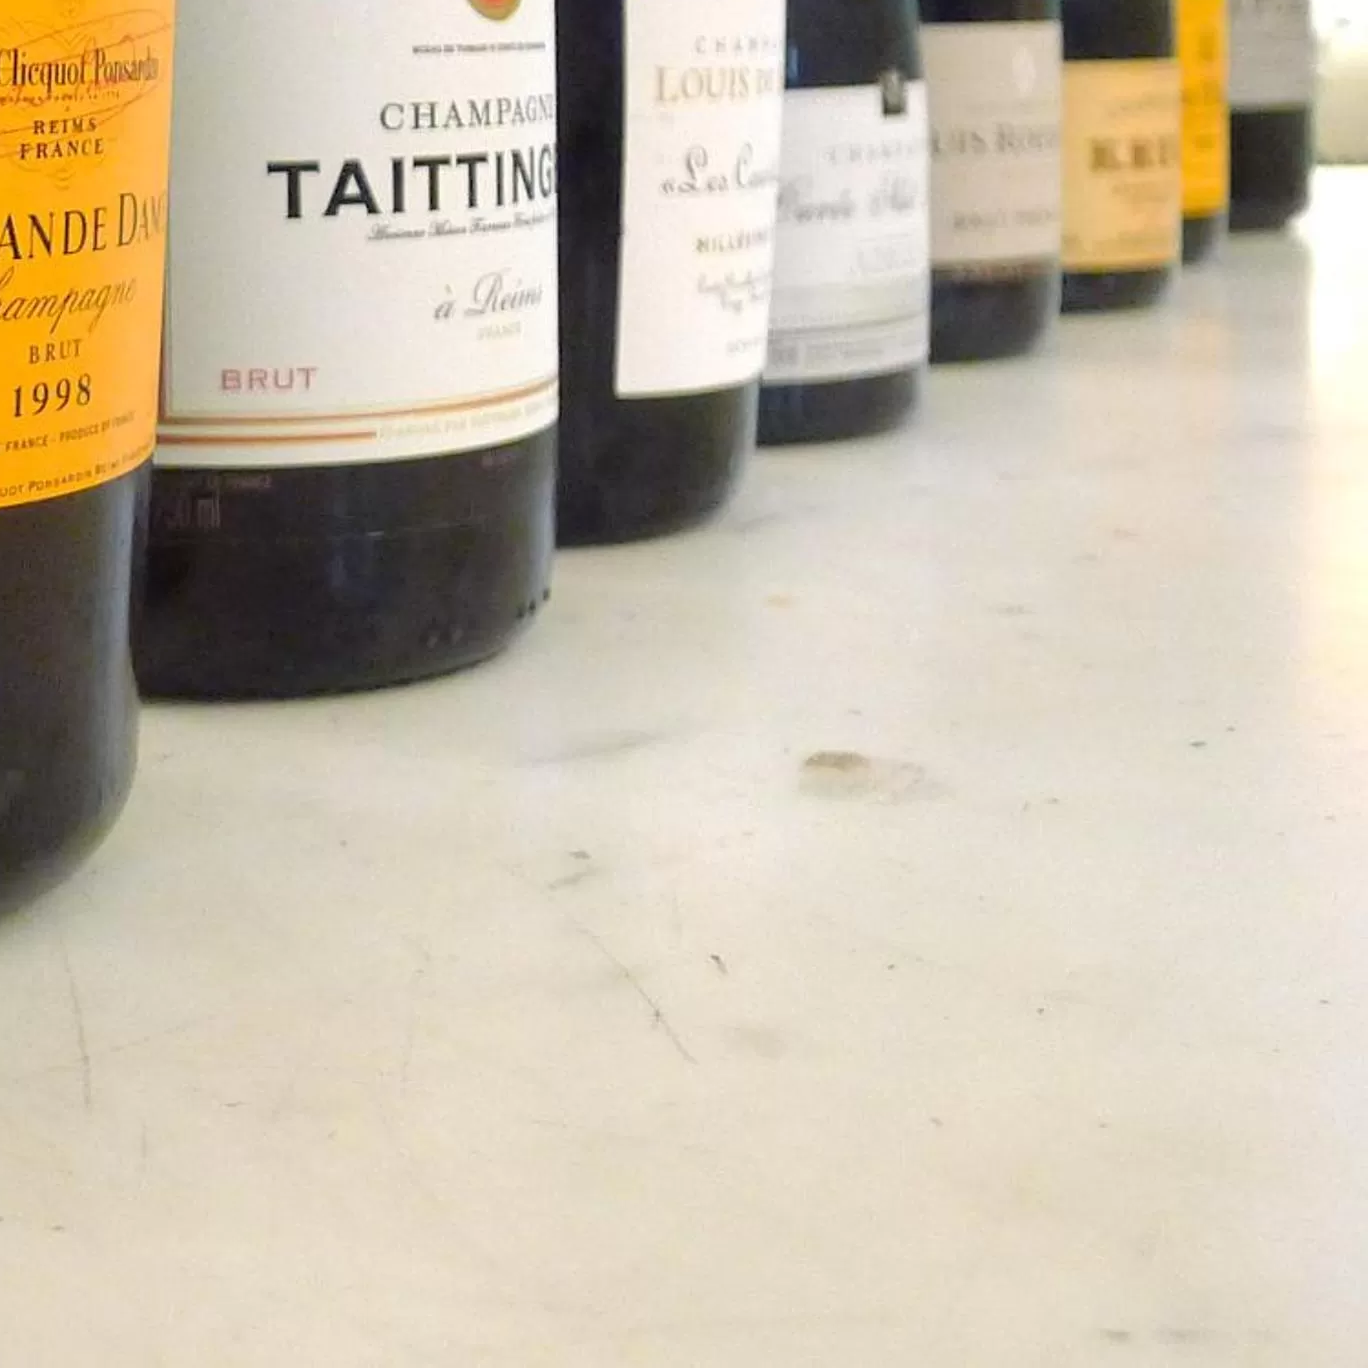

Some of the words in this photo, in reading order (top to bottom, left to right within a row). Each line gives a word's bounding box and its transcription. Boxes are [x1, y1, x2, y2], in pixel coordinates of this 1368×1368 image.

[652, 63, 751, 103] LOUIS
[33, 115, 98, 135] REIMS
[19, 138, 105, 161] FRANCE
[266, 142, 558, 220] TAITTING
[432, 283, 455, 322] à
[27, 338, 83, 366] BRUT
[219, 366, 319, 392] BRUT
[13, 373, 93, 419] 1998
[5, 433, 49, 454] FRANCE
